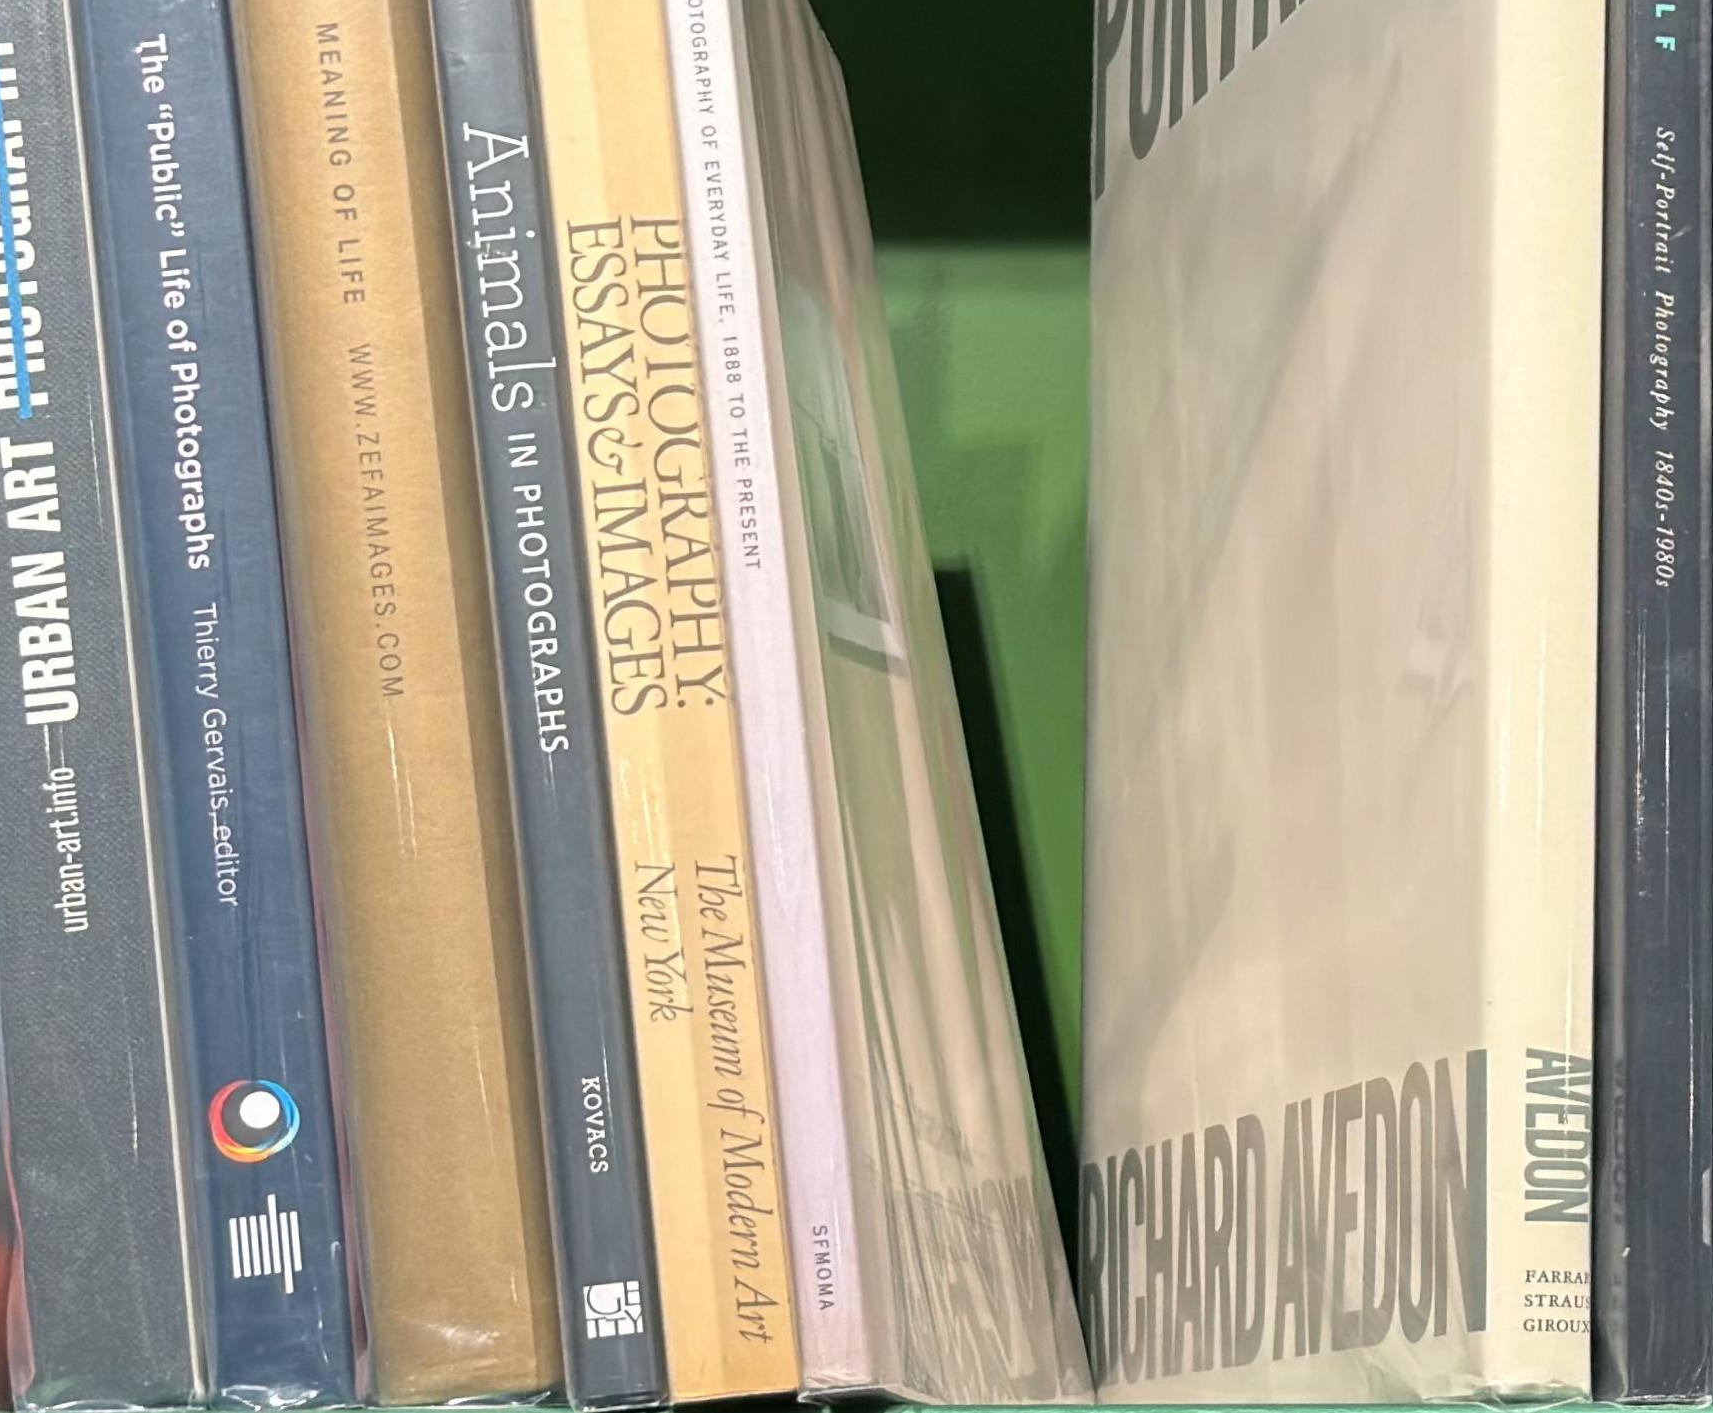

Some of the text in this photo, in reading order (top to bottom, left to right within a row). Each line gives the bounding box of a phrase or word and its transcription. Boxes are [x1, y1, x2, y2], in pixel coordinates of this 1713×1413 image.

[315, 21, 366, 306] MEANING OF LIFE
[463, 123, 570, 754] Animals IN PHOTOGRAPHS
[1650, 127, 1676, 589] Self-Portrait Photography 1840s-1980s
[0, 436, 62, 538] ART
[347, 343, 406, 700] WWW.ZEFAIMAGES.COM
[10, 551, 81, 726] URBAN
[592, 477, 668, 716] IMAGES
[51, 767, 88, 933] urban-art.info
[635, 863, 695, 1025] New York
[582, 1076, 610, 1174] KOVACS
[1524, 1048, 1593, 1224] AVEDON
[811, 1226, 837, 1311] SFMOMA
[1085, 1048, 1488, 1383] RICHARD AVEDON
